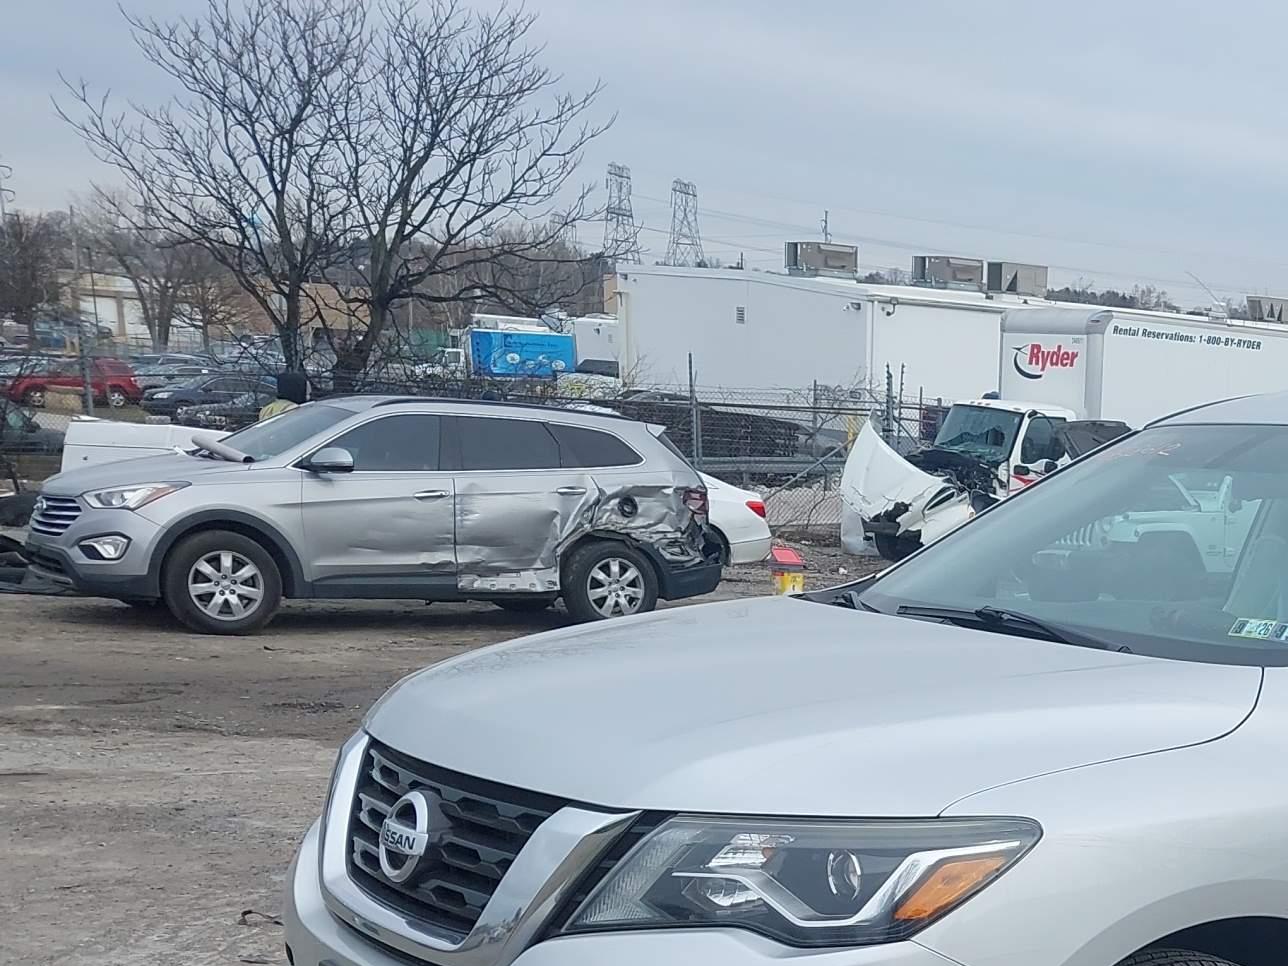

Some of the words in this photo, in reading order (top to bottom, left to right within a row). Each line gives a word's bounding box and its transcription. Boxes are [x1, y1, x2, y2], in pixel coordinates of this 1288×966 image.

[1113, 325, 1139, 337] Rental
[1142, 329, 1196, 343] Reservations:
[1199, 335, 1262, 350] 1-800-BY-RYDER
[1028, 343, 1079, 372] Ryder
